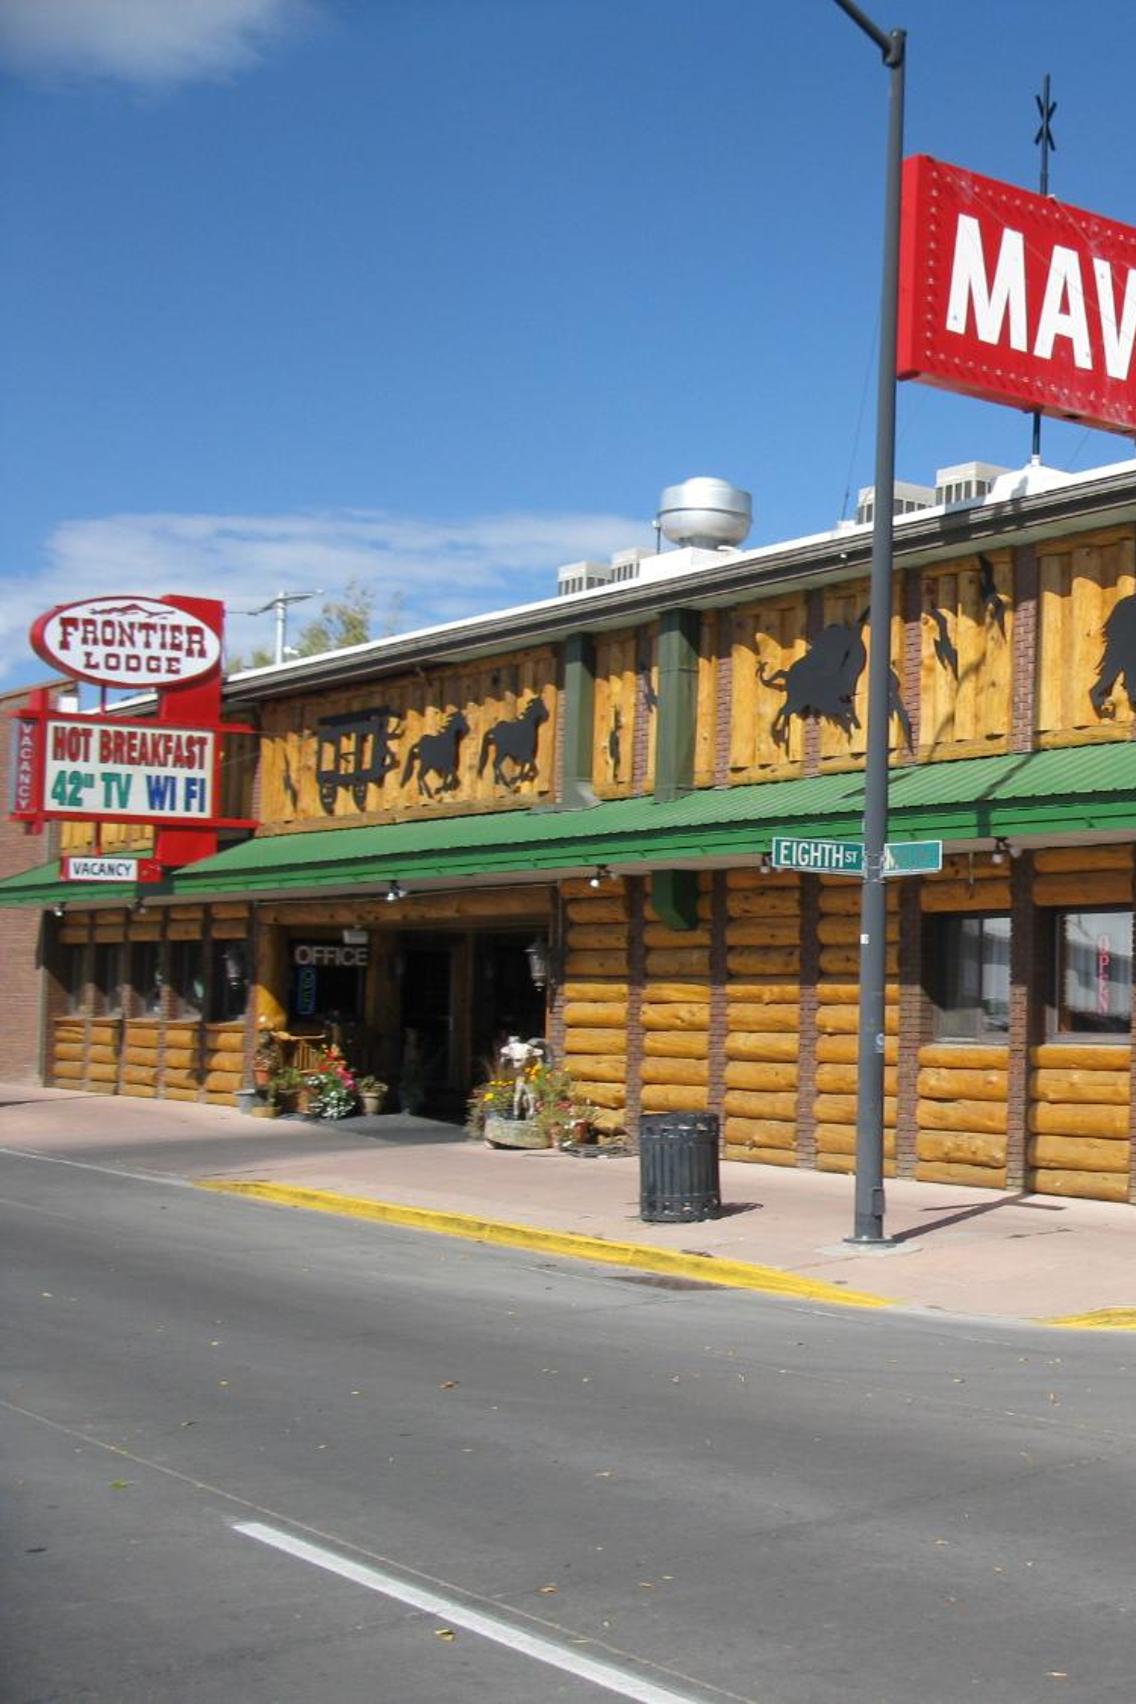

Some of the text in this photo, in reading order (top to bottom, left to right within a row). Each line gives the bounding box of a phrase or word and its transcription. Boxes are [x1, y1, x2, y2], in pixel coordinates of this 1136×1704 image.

[58, 616, 207, 658] FRONTIER
[84, 650, 182, 675] LODGE
[18, 721, 33, 810] VACANCY
[52, 725, 208, 771] HOT BREAKFAST
[101, 771, 133, 809] TV
[146, 774, 177, 812] WI
[184, 776, 206, 814] FI
[72, 861, 133, 877] VACANCY
[779, 841, 857, 868] EIGHTH ST
[295, 945, 368, 966] OFFICE
[1098, 934, 1110, 1014] OPEN
